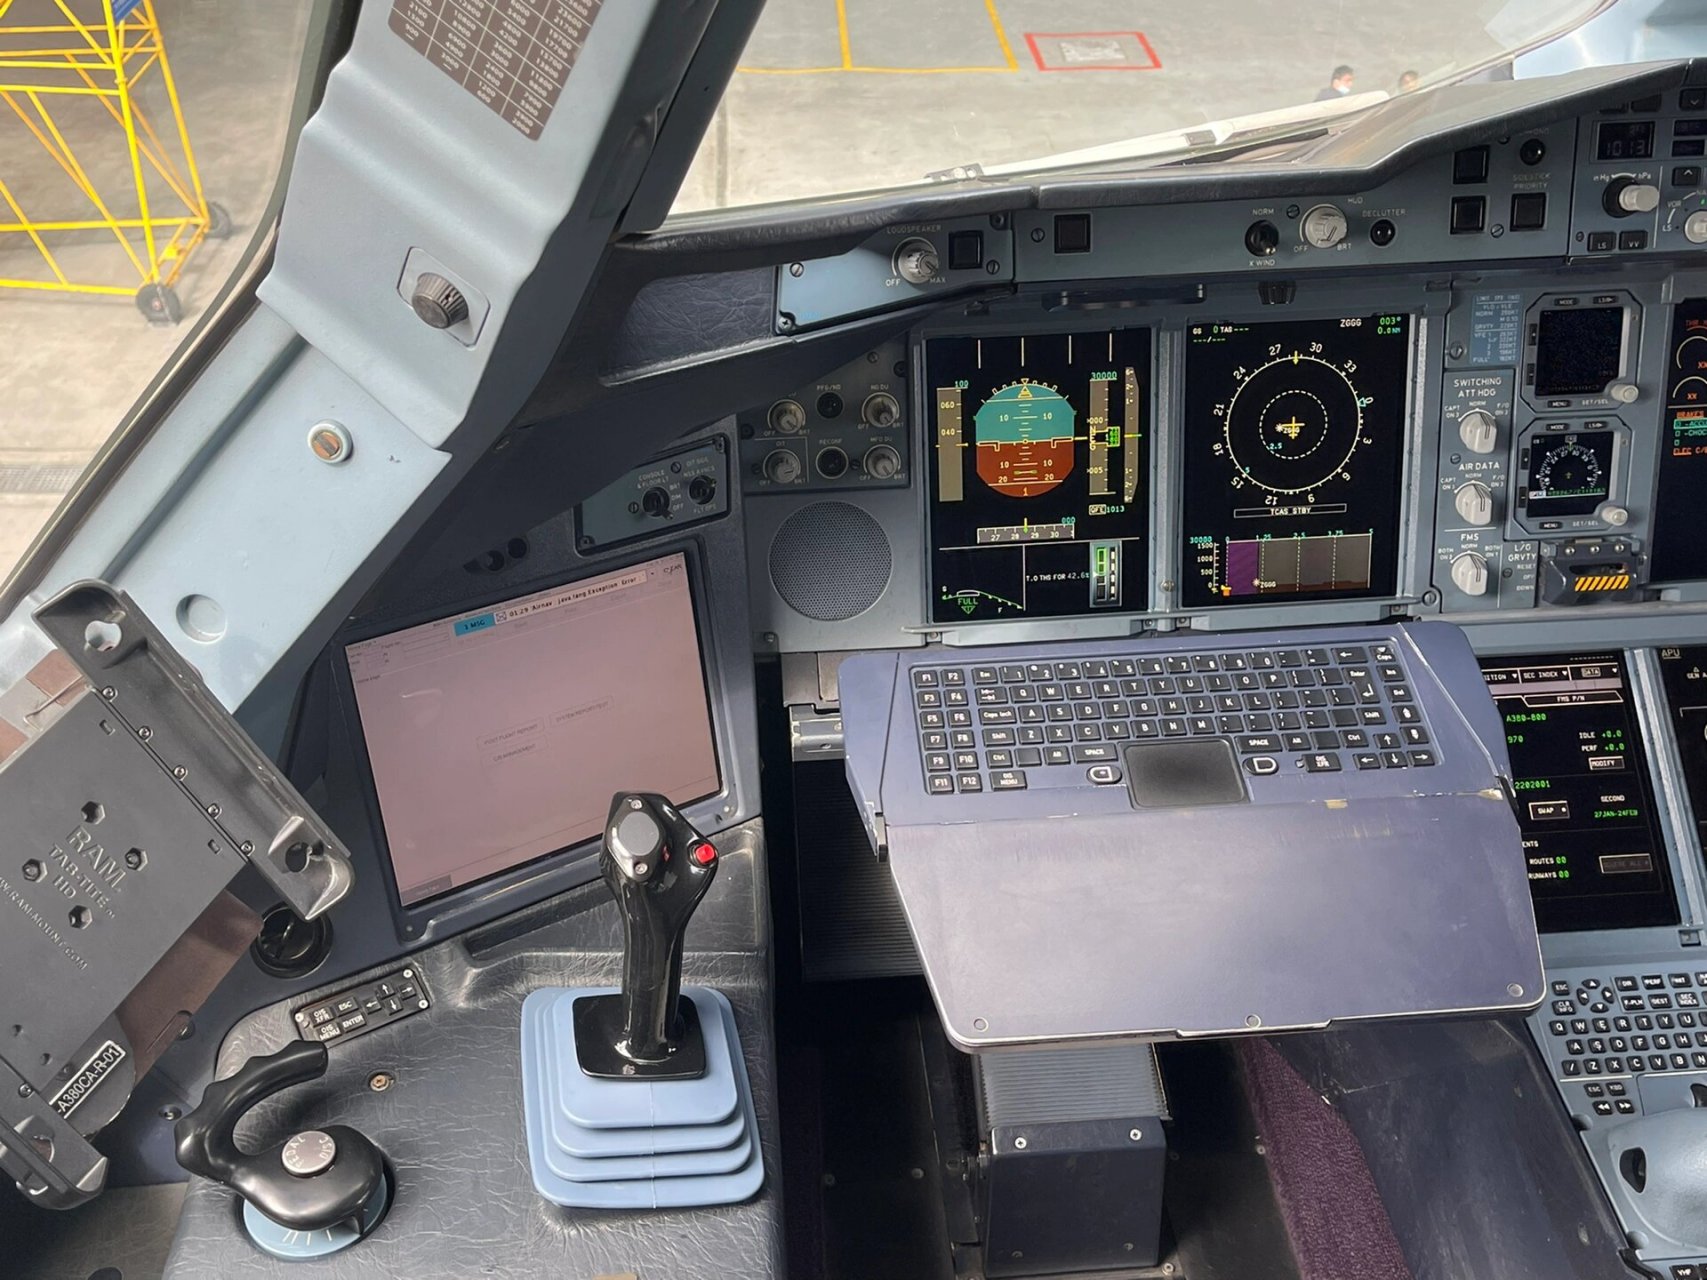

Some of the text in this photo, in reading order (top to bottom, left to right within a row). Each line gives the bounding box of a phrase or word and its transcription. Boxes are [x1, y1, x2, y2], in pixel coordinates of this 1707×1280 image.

[478, 81, 496, 97] 1200
[1362, 209, 1405, 217] DECLUTTER
[887, 224, 942, 234] LOUDSPEAKER
[930, 276, 946, 284] MAX
[1340, 319, 1362, 327] ZGGG
[1269, 344, 1282, 356] 27
[1310, 343, 1323, 352] 30
[1344, 360, 1357, 373] 33
[1233, 366, 1246, 380] 24
[1454, 377, 1501, 386] SWITCHING
[1458, 388, 1496, 397] ATT HDG
[1213, 404, 1224, 416] 21
[1043, 412, 1052, 420] 10
[1213, 443, 1224, 456] 18
[1043, 459, 1052, 467] 10
[1231, 476, 1245, 490] 15
[1265, 495, 1279, 505] 12
[1270, 507, 1311, 516] TCAS STBY
[1514, 544, 1531, 552] L/G
[1508, 554, 1536, 562] GRVTY
[470, 620, 485, 628] MSG
[1662, 649, 1680, 657] APU
[923, 674, 931, 682] F1
[925, 694, 935, 702] F3
[931, 735, 940, 743] F7
[935, 778, 948, 786] F11
[66, 825, 126, 888] RAM
[1529, 857, 1554, 865] ROUTES
[49, 844, 109, 908] TAB-TITE
[53, 875, 76, 899] HD
[338, 1001, 352, 1010] ESC
[314, 1009, 326, 1017] OIS
[316, 1014, 329, 1023] XFR
[342, 1014, 363, 1028] ENTER
[321, 1024, 333, 1033] OIS
[320, 1028, 341, 1040] MENU
[57, 1045, 120, 1114] -A380CA-R-01
